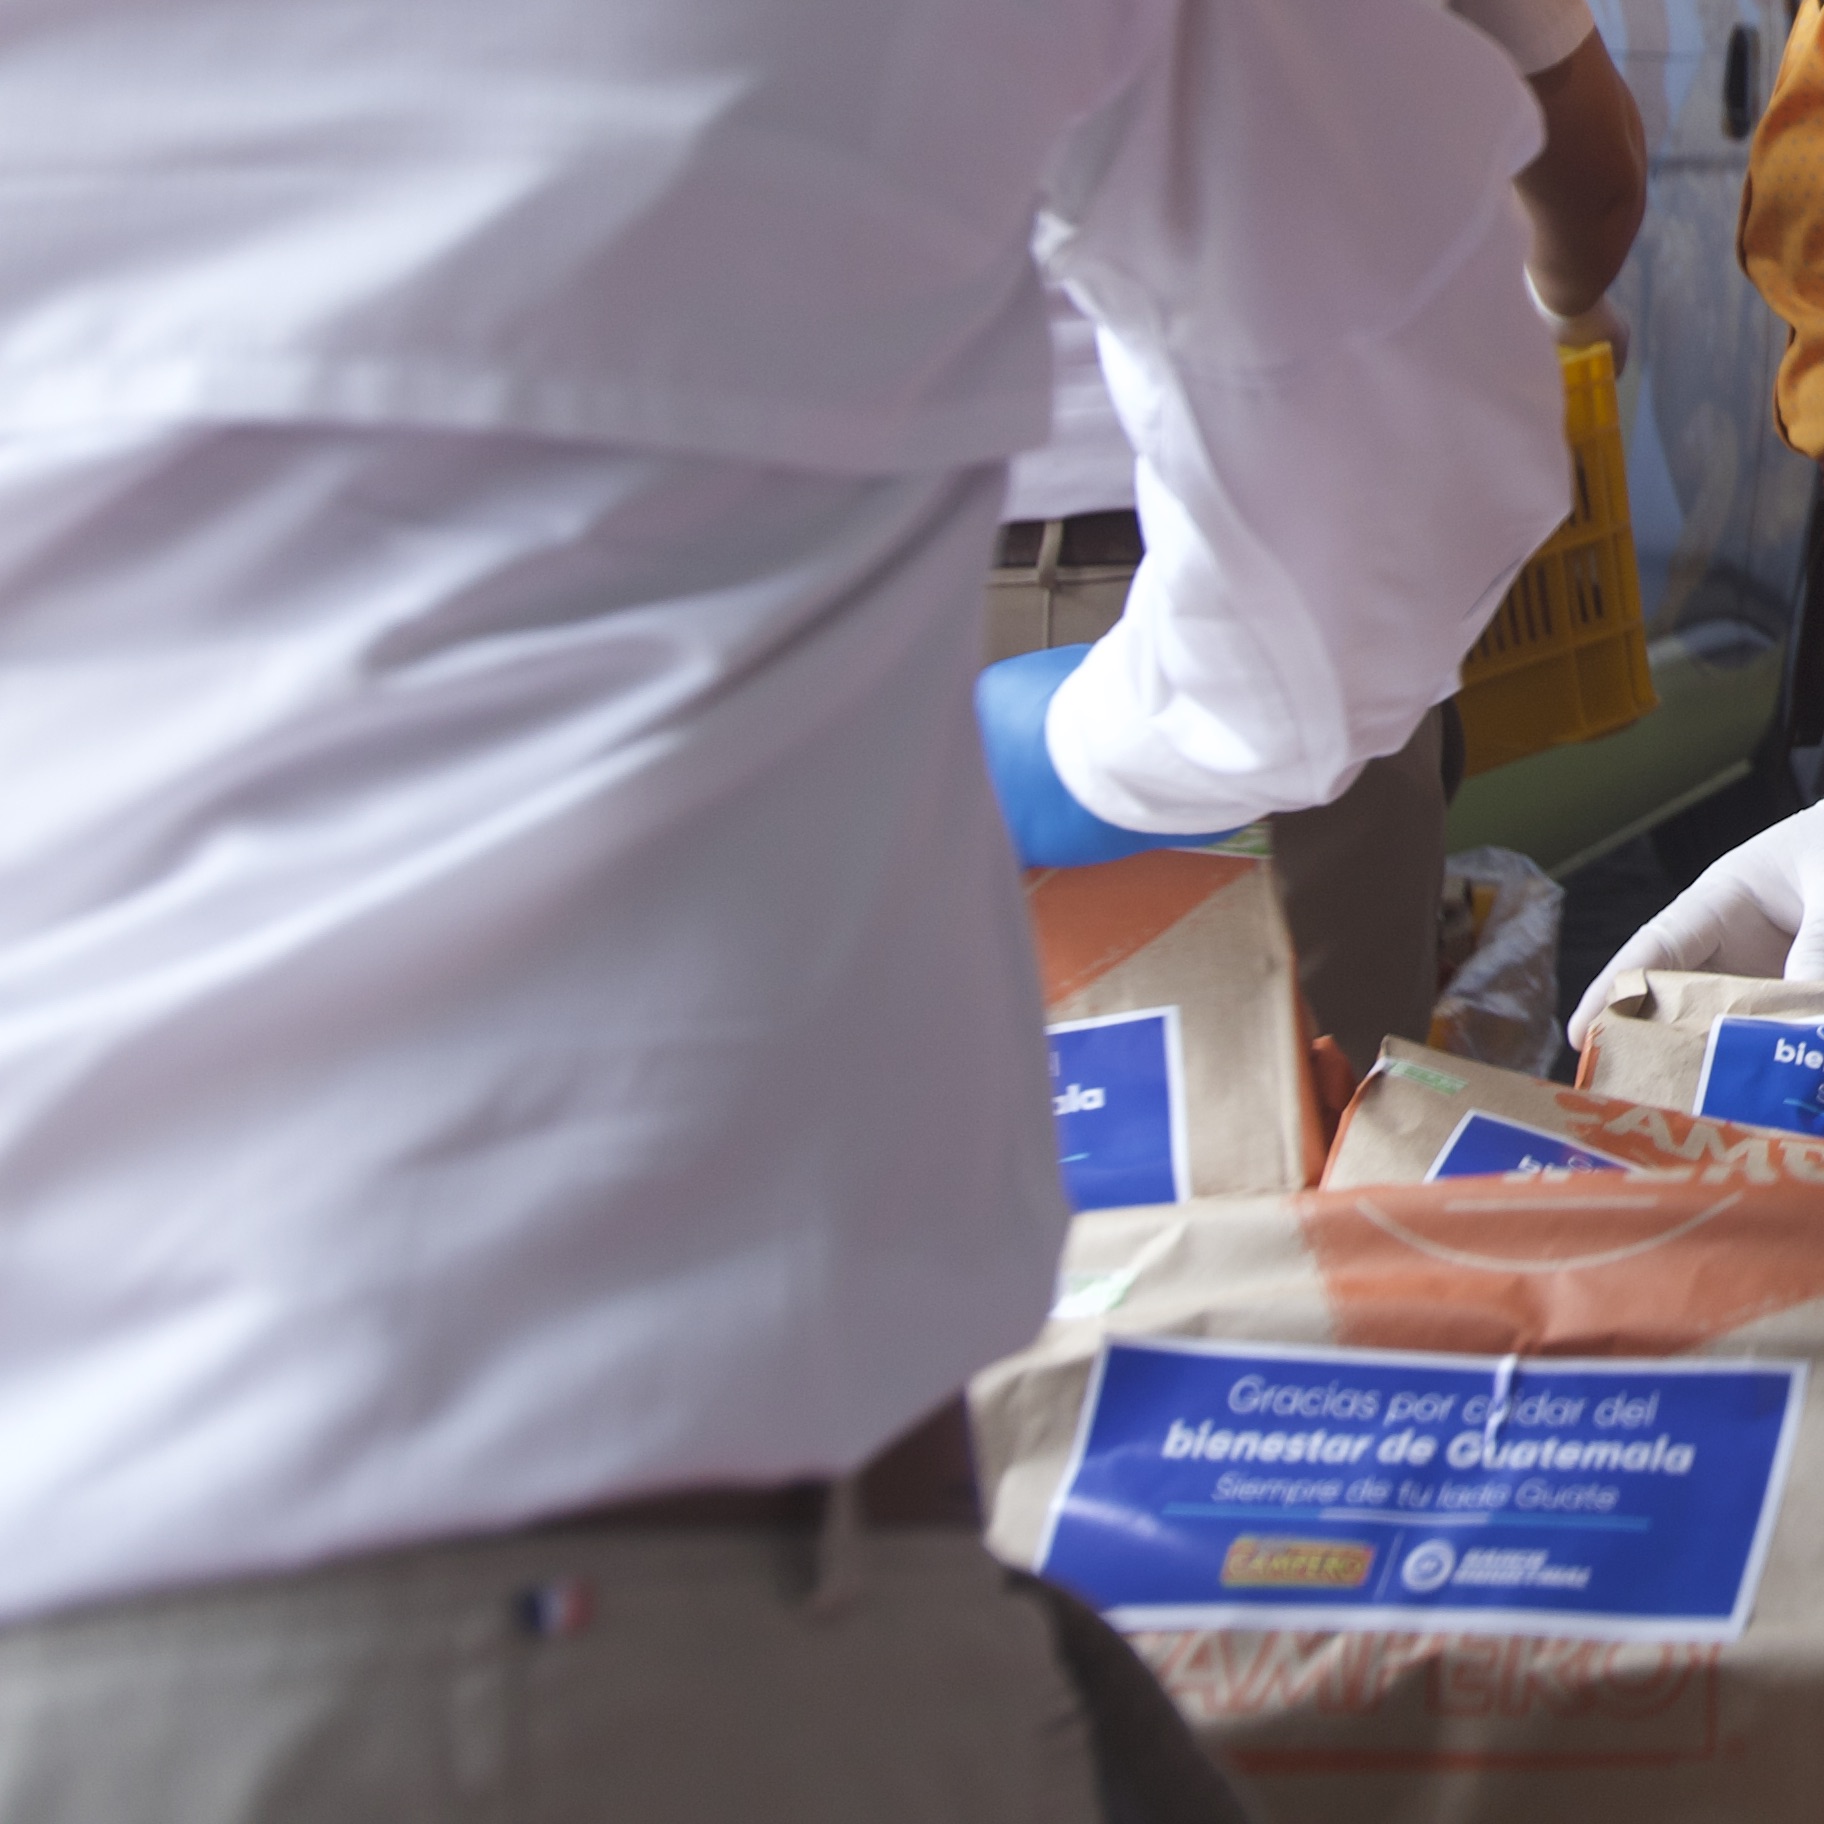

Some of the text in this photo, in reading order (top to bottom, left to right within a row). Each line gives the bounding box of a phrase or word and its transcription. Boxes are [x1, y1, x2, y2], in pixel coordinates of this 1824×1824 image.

[1227, 1372, 1661, 1429] Gracias por cidar del
[1161, 1417, 1697, 1476] bienestar de Guatemala
